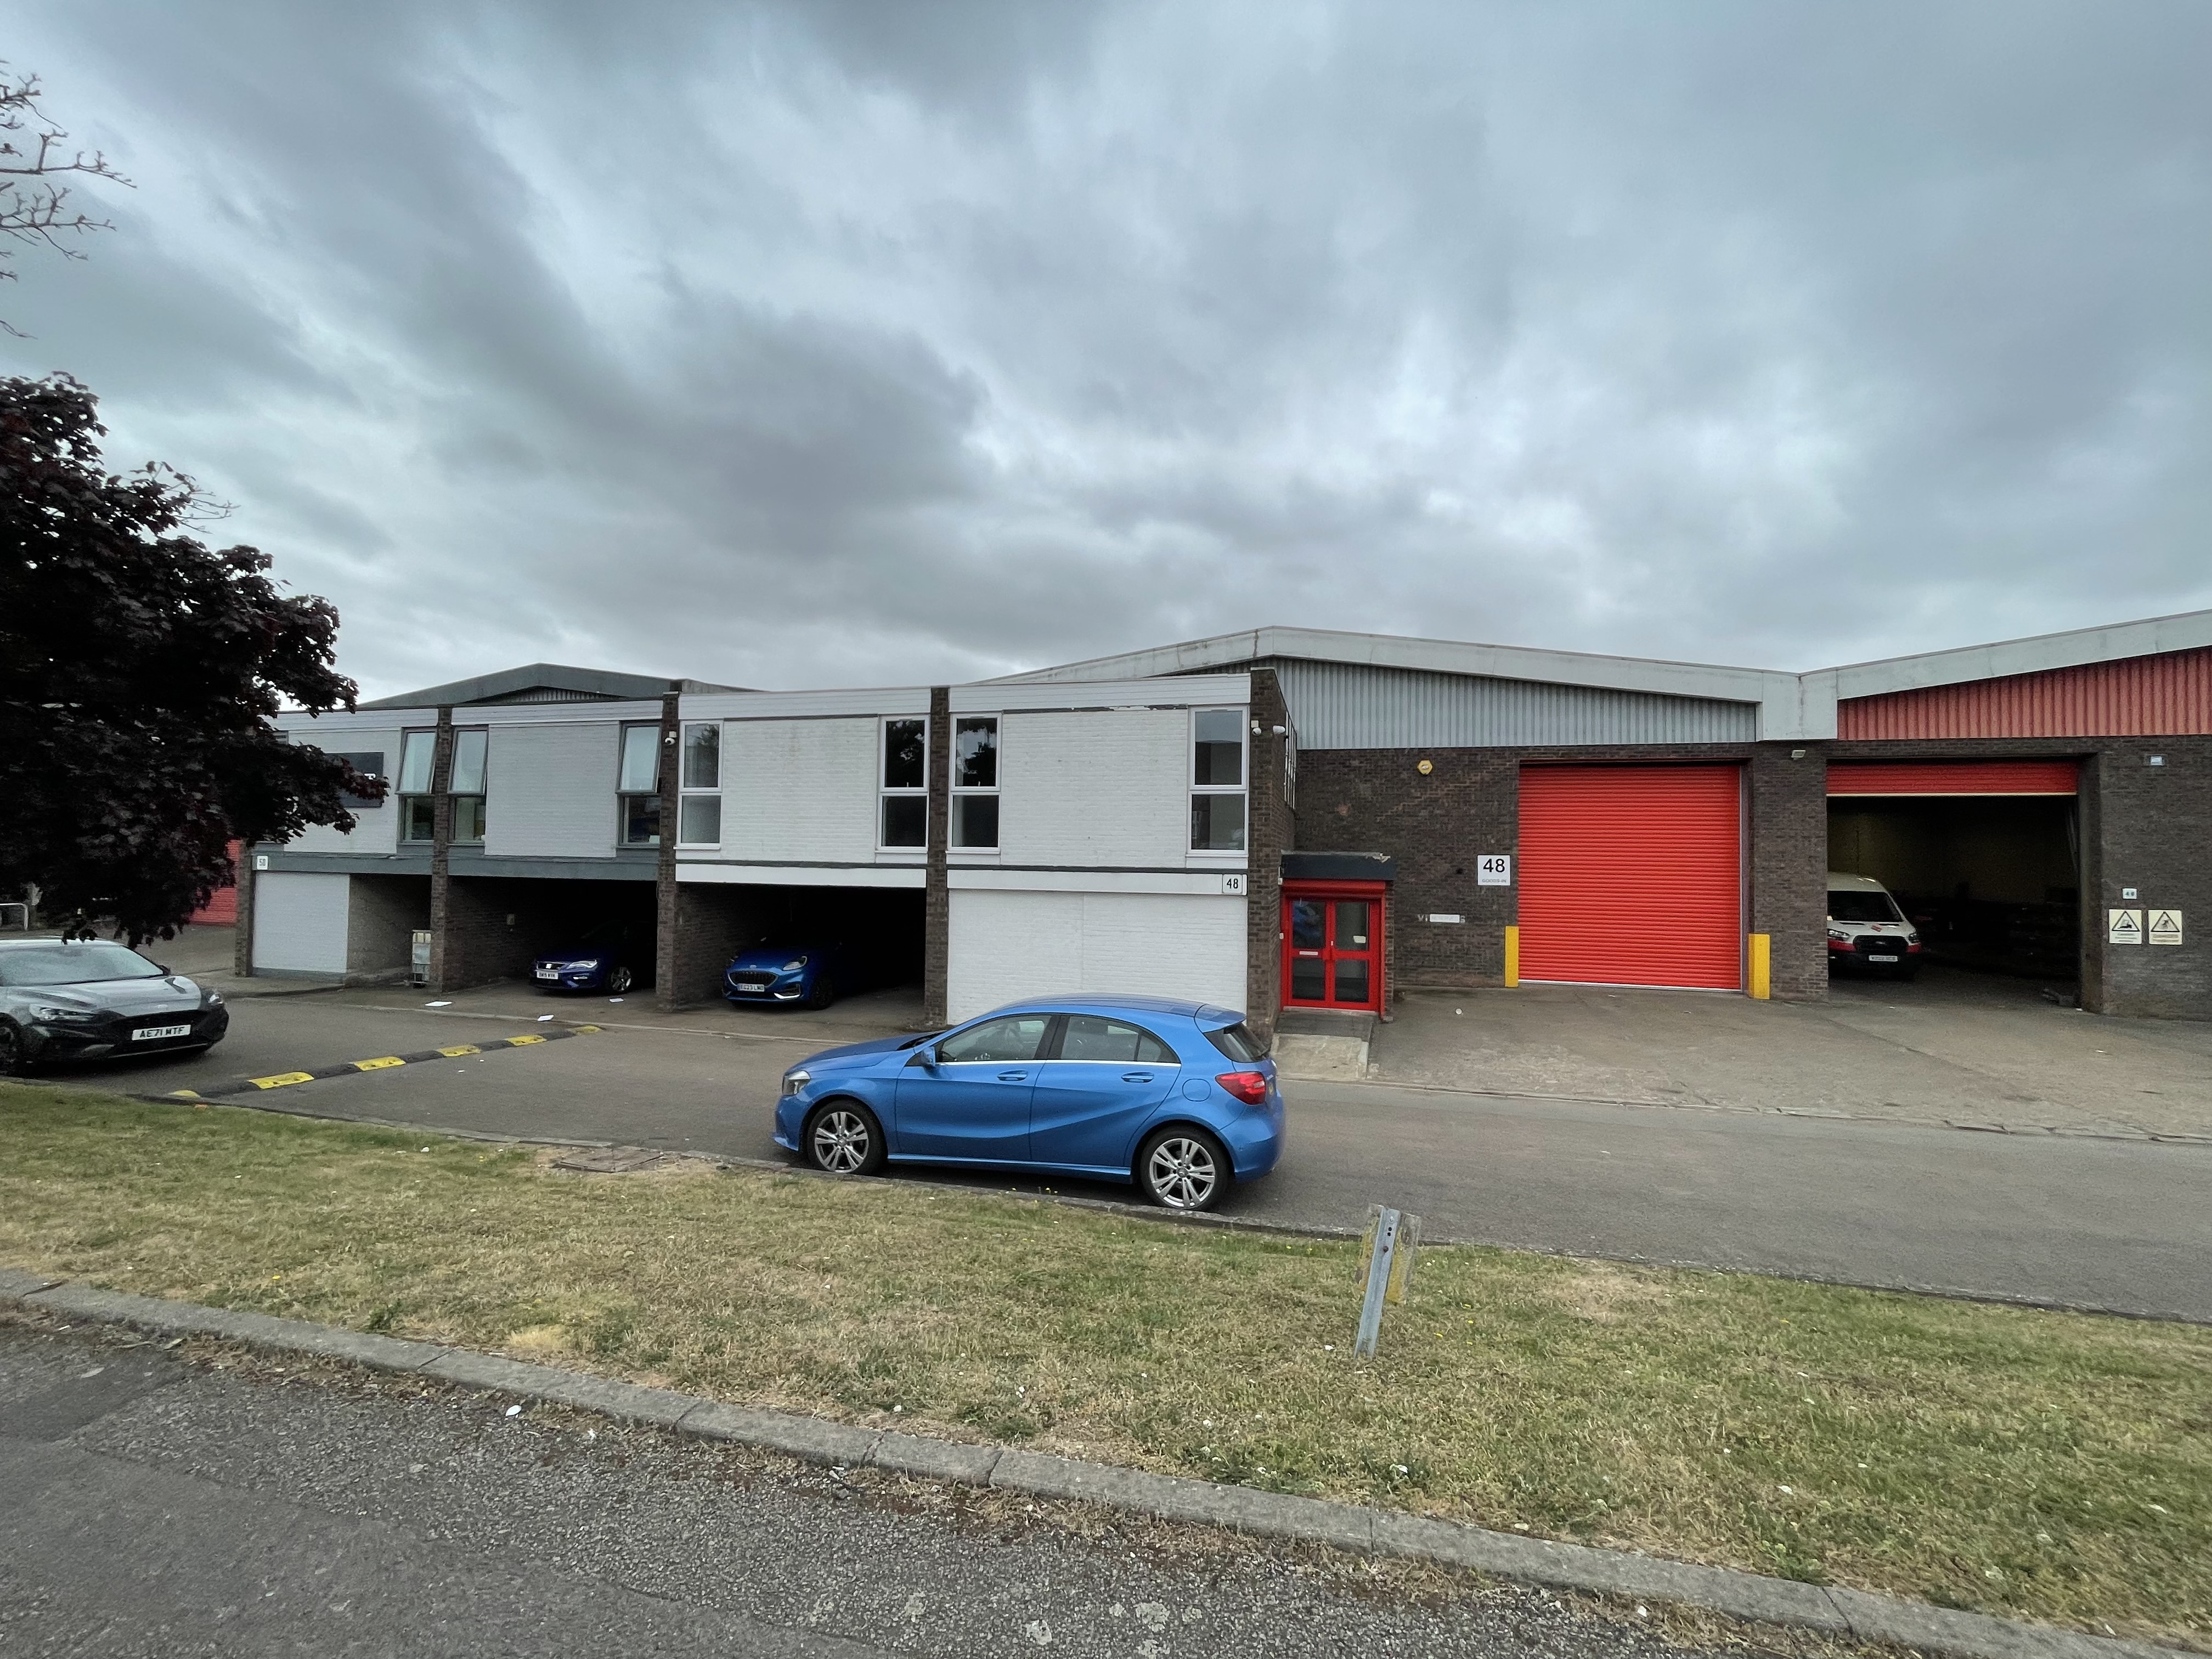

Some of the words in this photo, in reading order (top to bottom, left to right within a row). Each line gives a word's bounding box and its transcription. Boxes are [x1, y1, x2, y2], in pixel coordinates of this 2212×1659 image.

[1483, 858, 1505, 872] 48
[1226, 878, 1238, 889] 48
[139, 1028, 163, 1037] AE71
